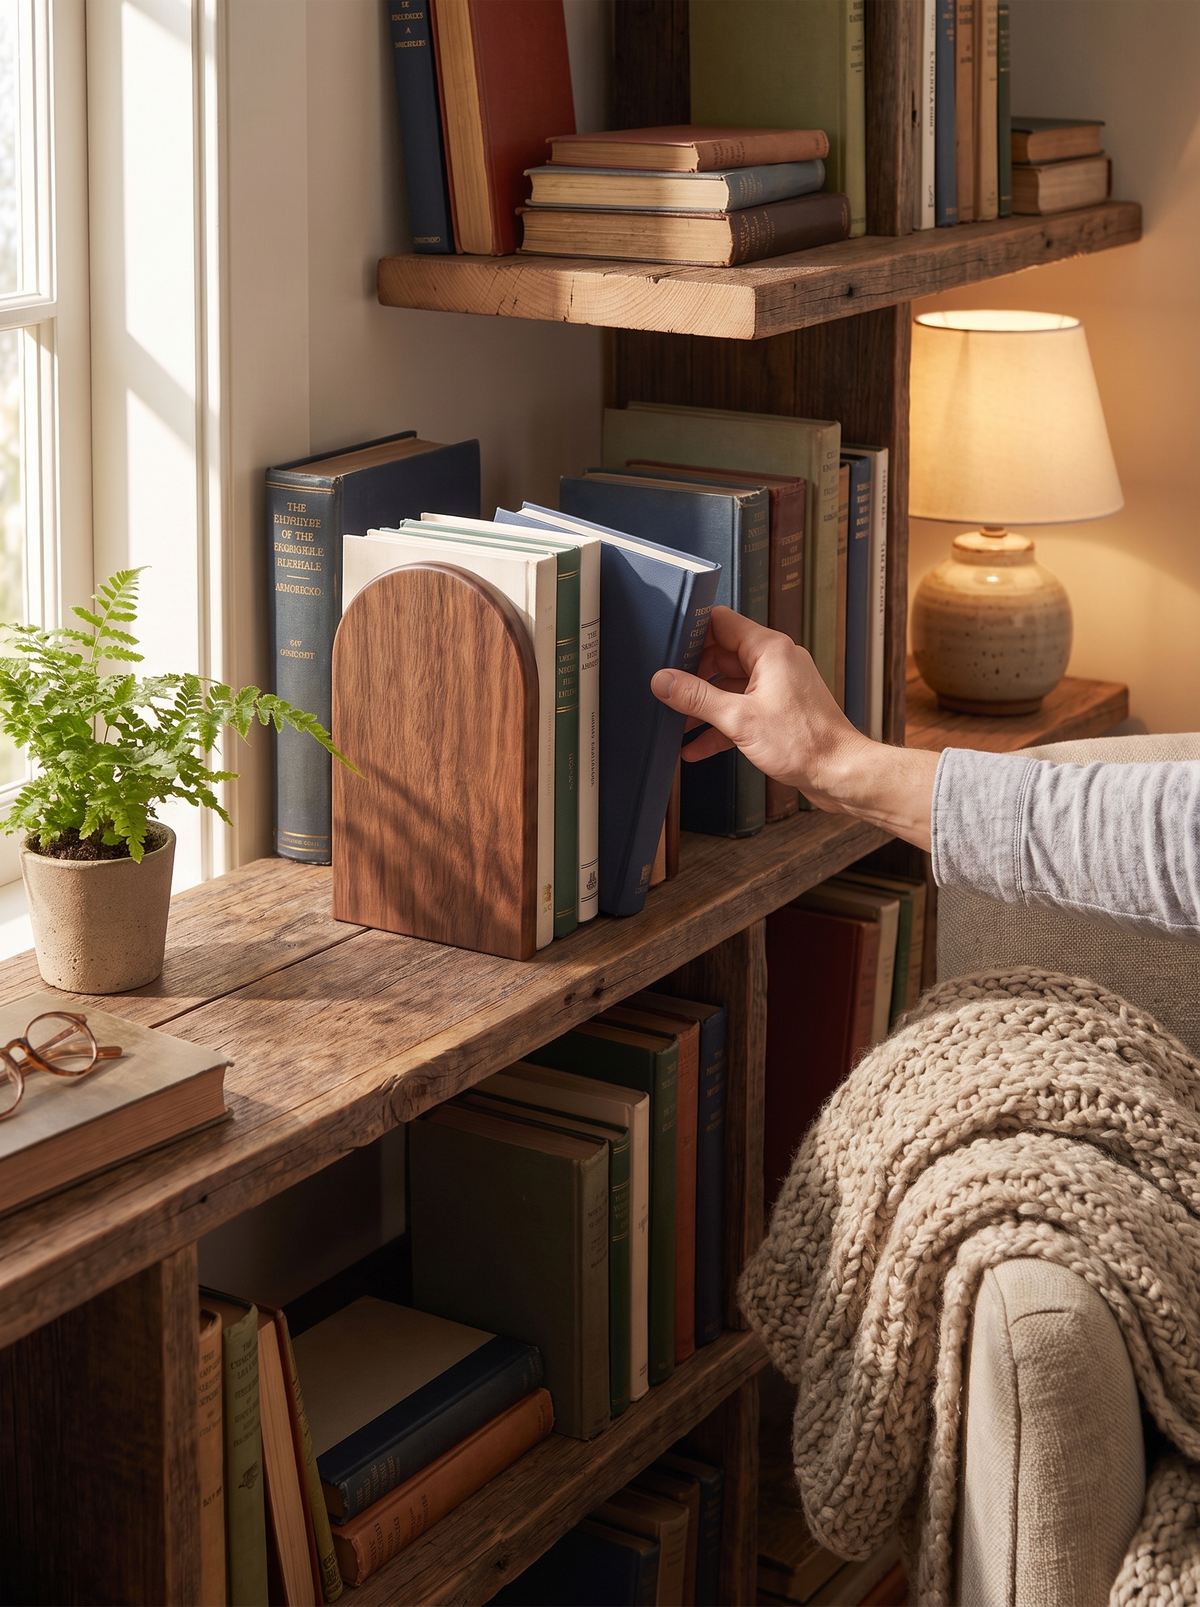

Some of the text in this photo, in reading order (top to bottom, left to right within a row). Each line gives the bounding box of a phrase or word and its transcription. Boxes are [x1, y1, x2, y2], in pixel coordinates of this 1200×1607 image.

[286, 502, 307, 513] THE
[281, 529, 315, 542] OF THE
